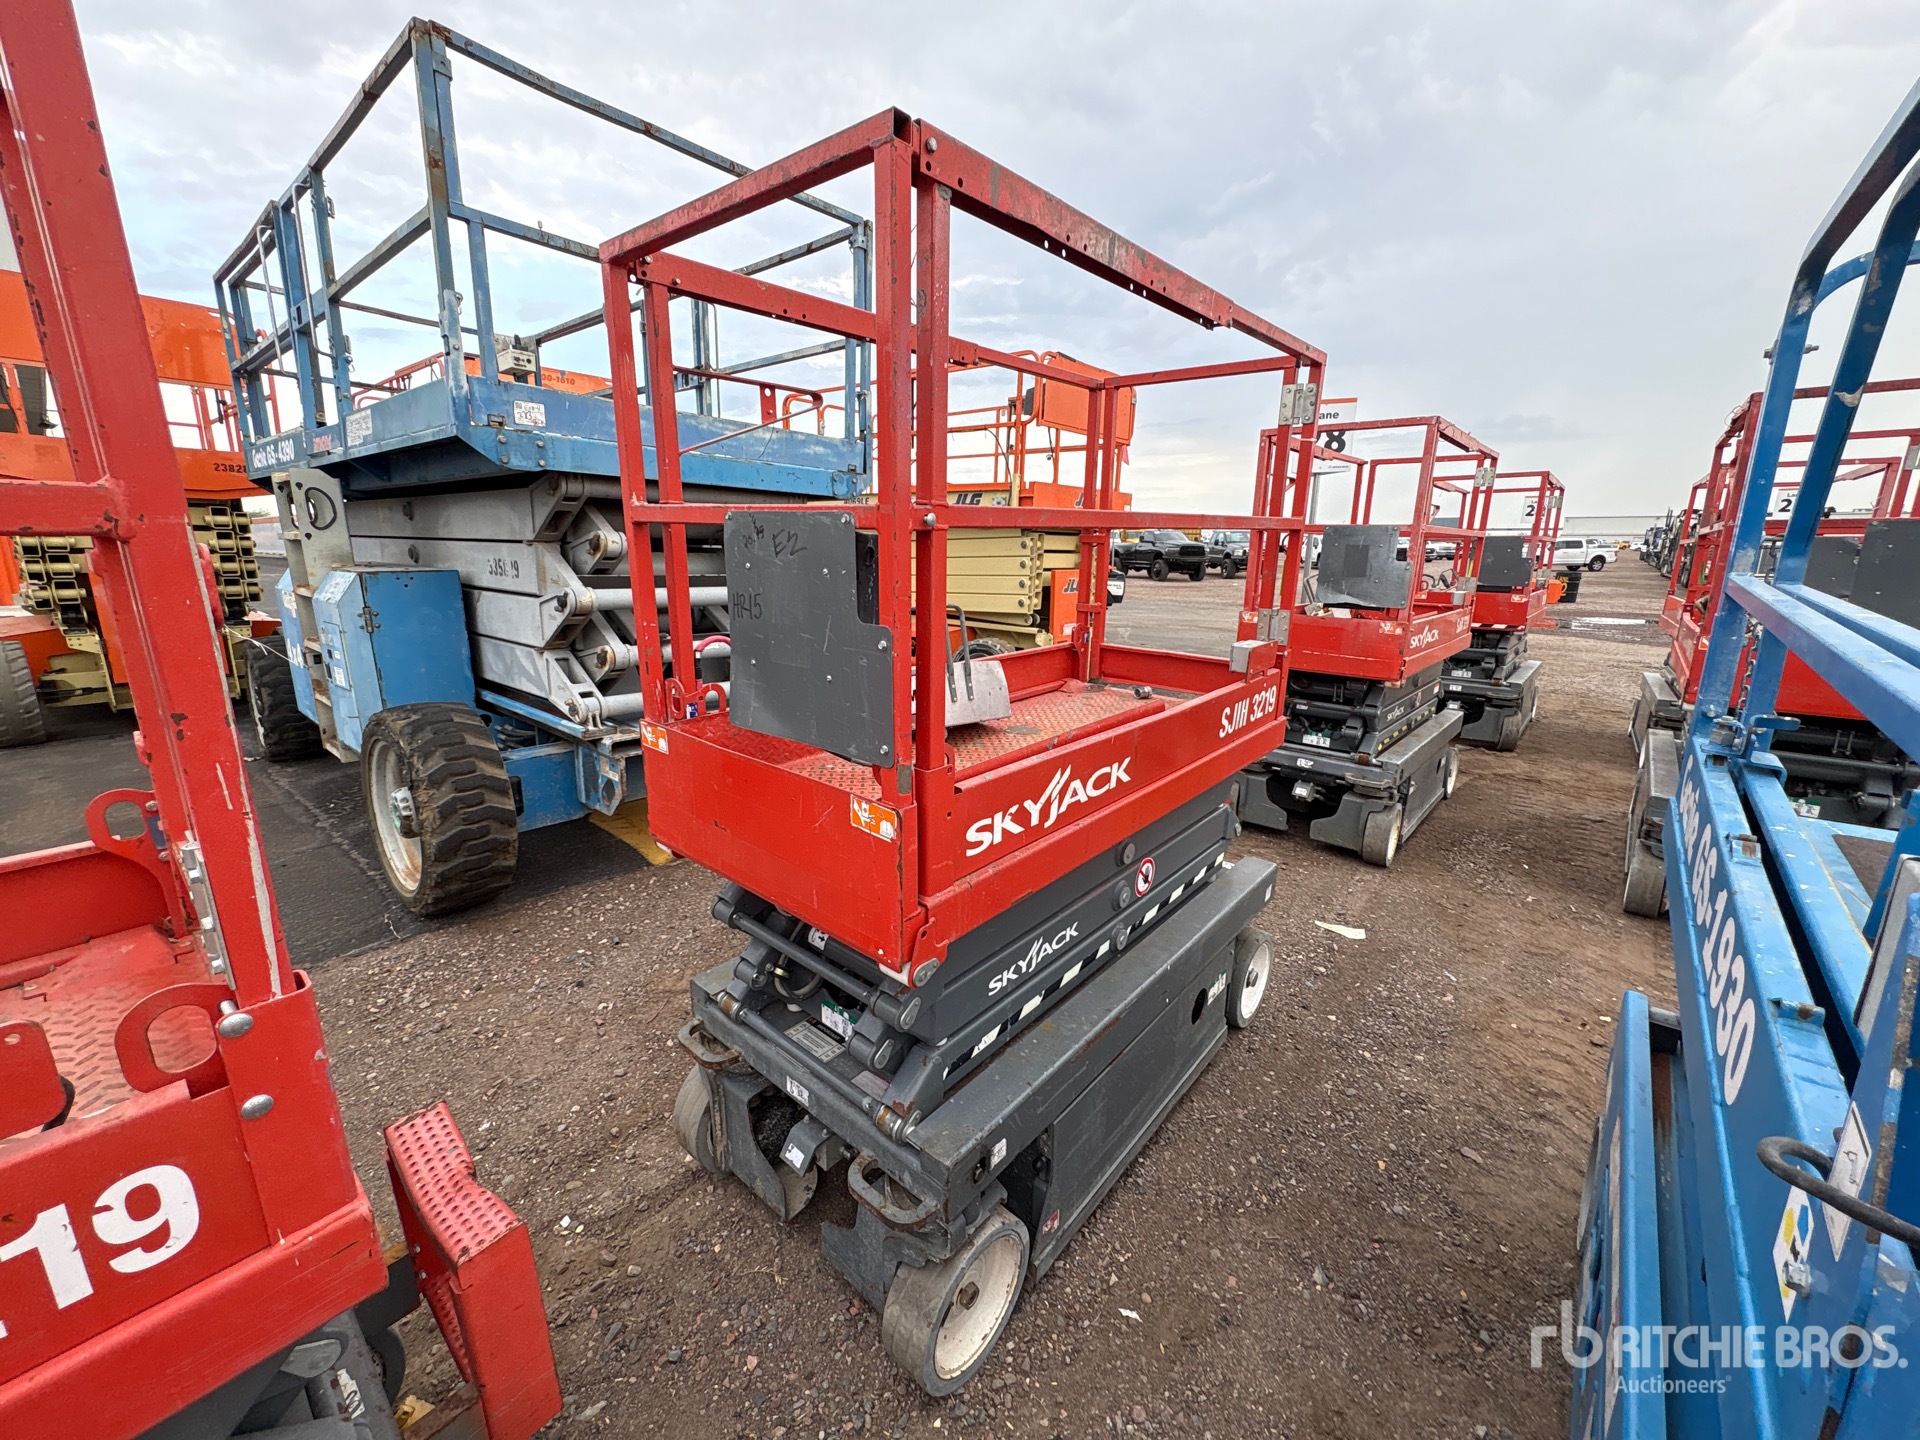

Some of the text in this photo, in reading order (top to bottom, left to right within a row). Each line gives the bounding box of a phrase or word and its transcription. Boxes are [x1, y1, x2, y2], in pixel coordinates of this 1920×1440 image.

[1319, 411, 1340, 420] ane
[953, 492, 983, 506] JLG
[1409, 624, 1439, 649] SKYJACK
[1250, 685, 1277, 722] 3219
[965, 756, 1132, 857] SKYJACK
[1679, 753, 1756, 1106] Genie GS-1930
[988, 920, 1080, 997] SKYJACK
[0, 1164, 200, 1338] 19
